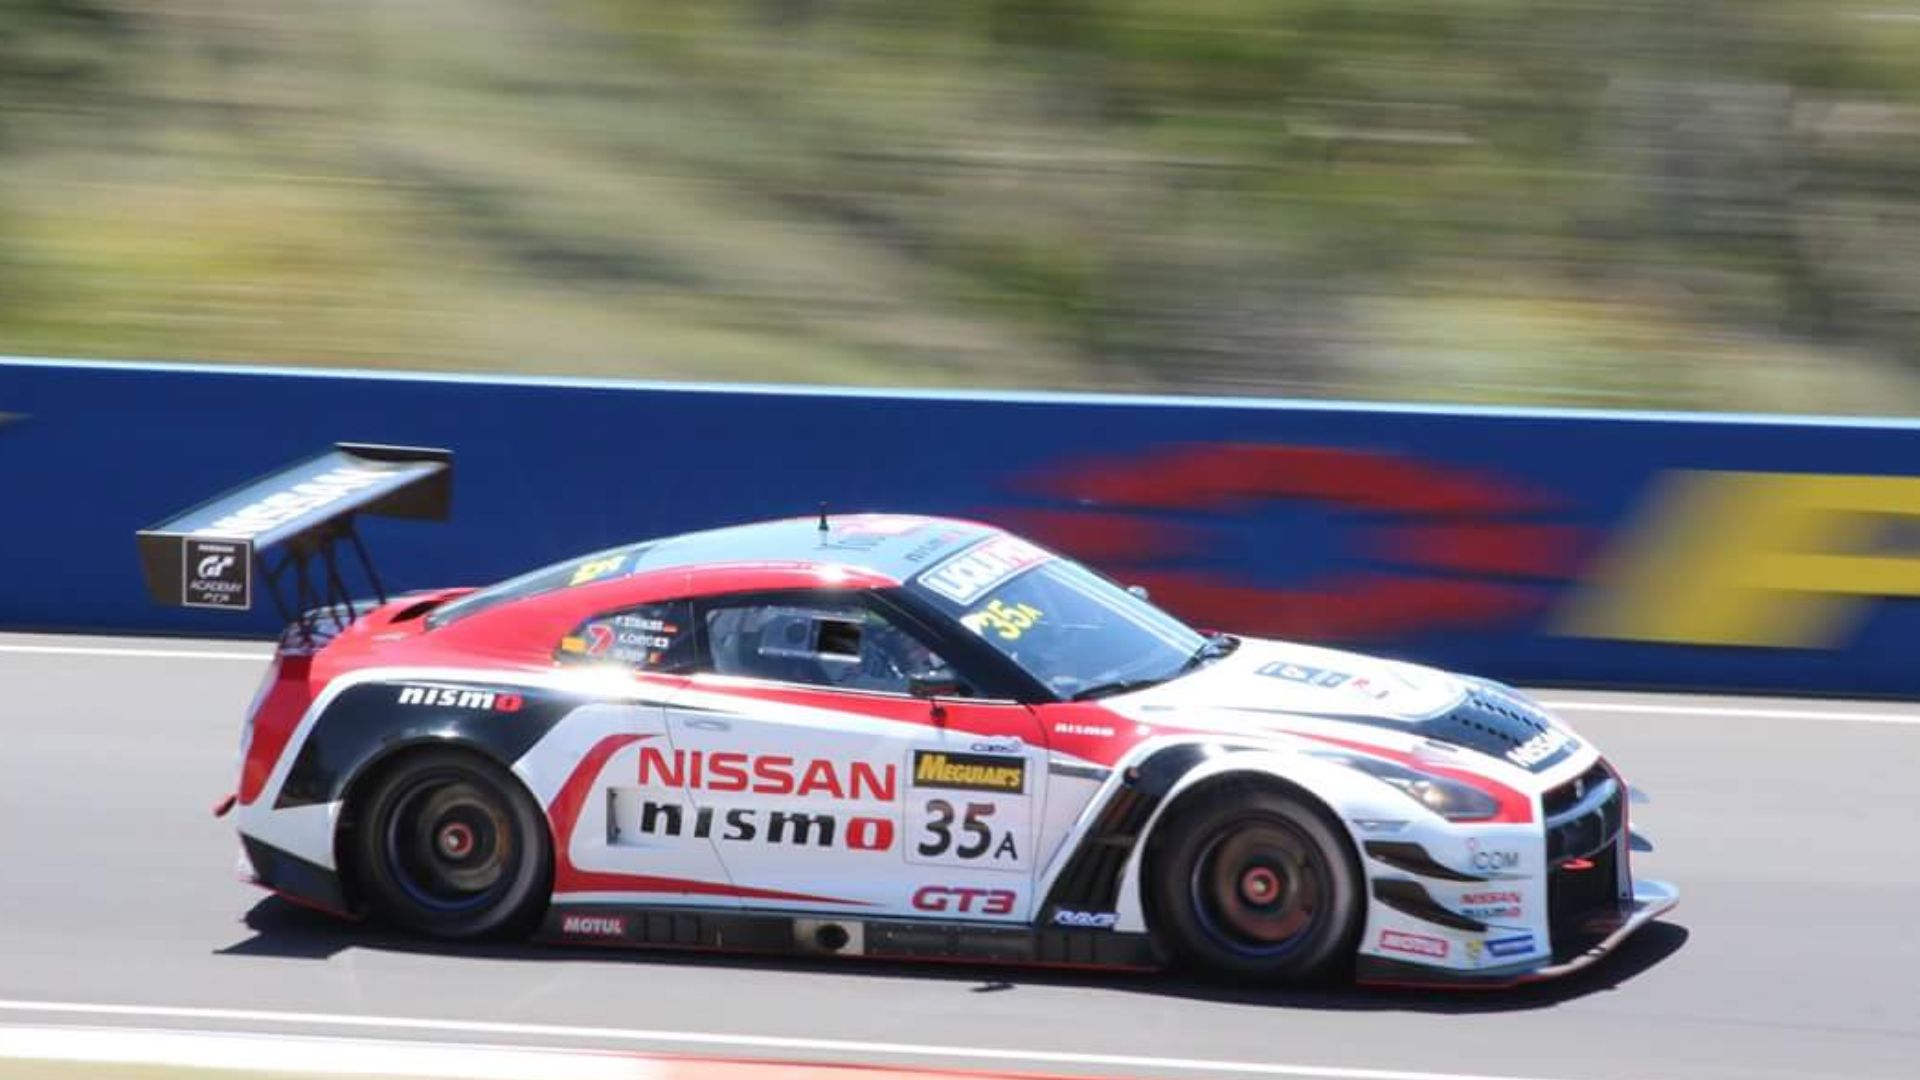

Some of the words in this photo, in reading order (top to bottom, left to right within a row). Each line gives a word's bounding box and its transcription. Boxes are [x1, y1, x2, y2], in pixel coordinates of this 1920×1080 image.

[398, 688, 523, 712] nismo
[638, 747, 896, 801] NISSAN
[641, 801, 895, 851] nismo
[912, 886, 1017, 915] GT3
[563, 916, 624, 934] MOTUL
